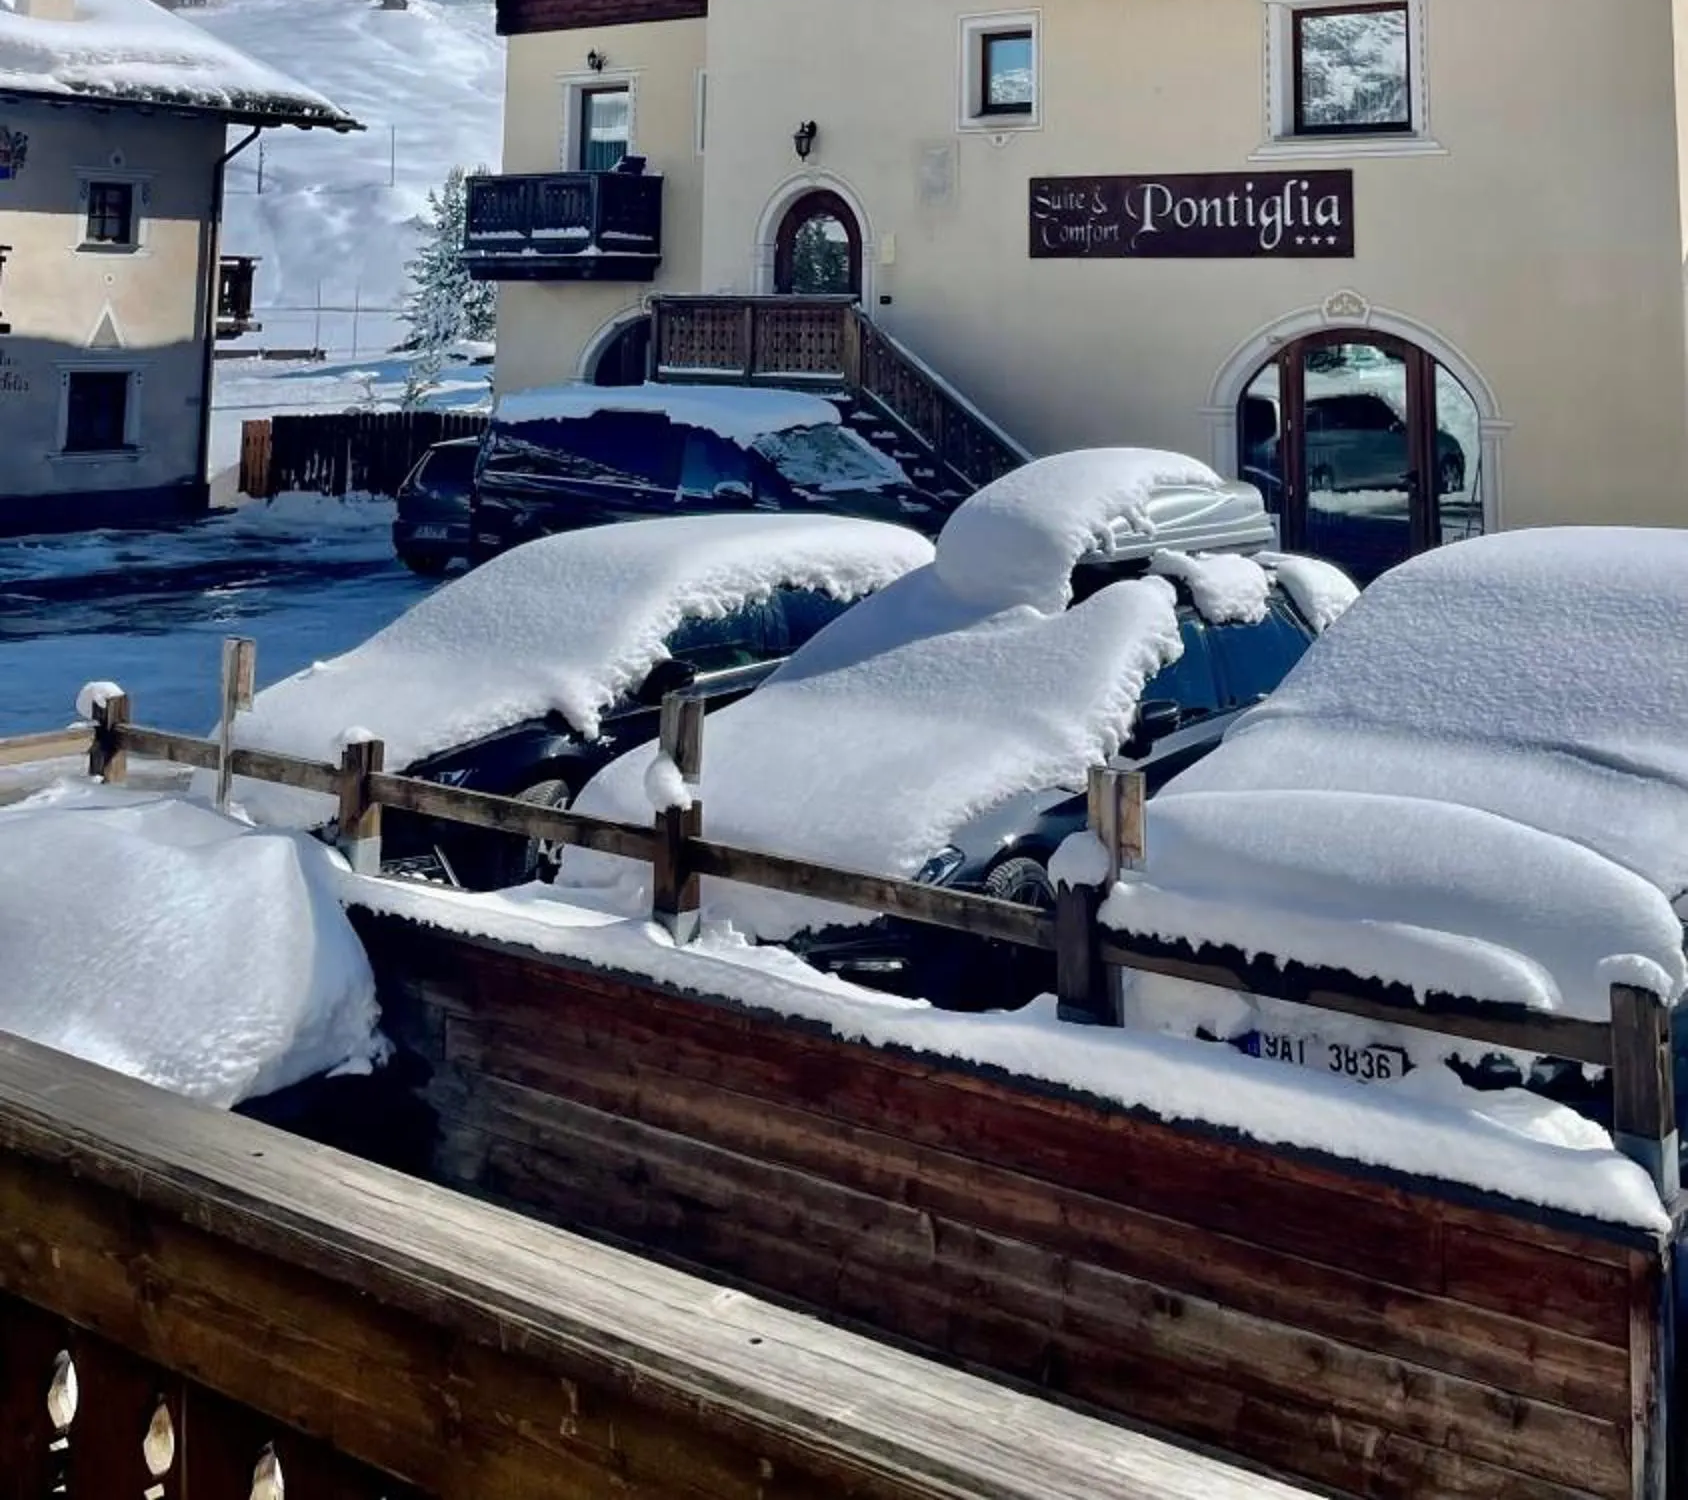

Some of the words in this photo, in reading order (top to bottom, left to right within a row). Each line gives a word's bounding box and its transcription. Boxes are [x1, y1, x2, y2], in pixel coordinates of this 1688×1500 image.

[1033, 185, 1086, 219] Suite
[1125, 179, 1341, 250] Pontiglia
[1041, 216, 1120, 253] Comfort
[1327, 1043, 1391, 1079] 3836
